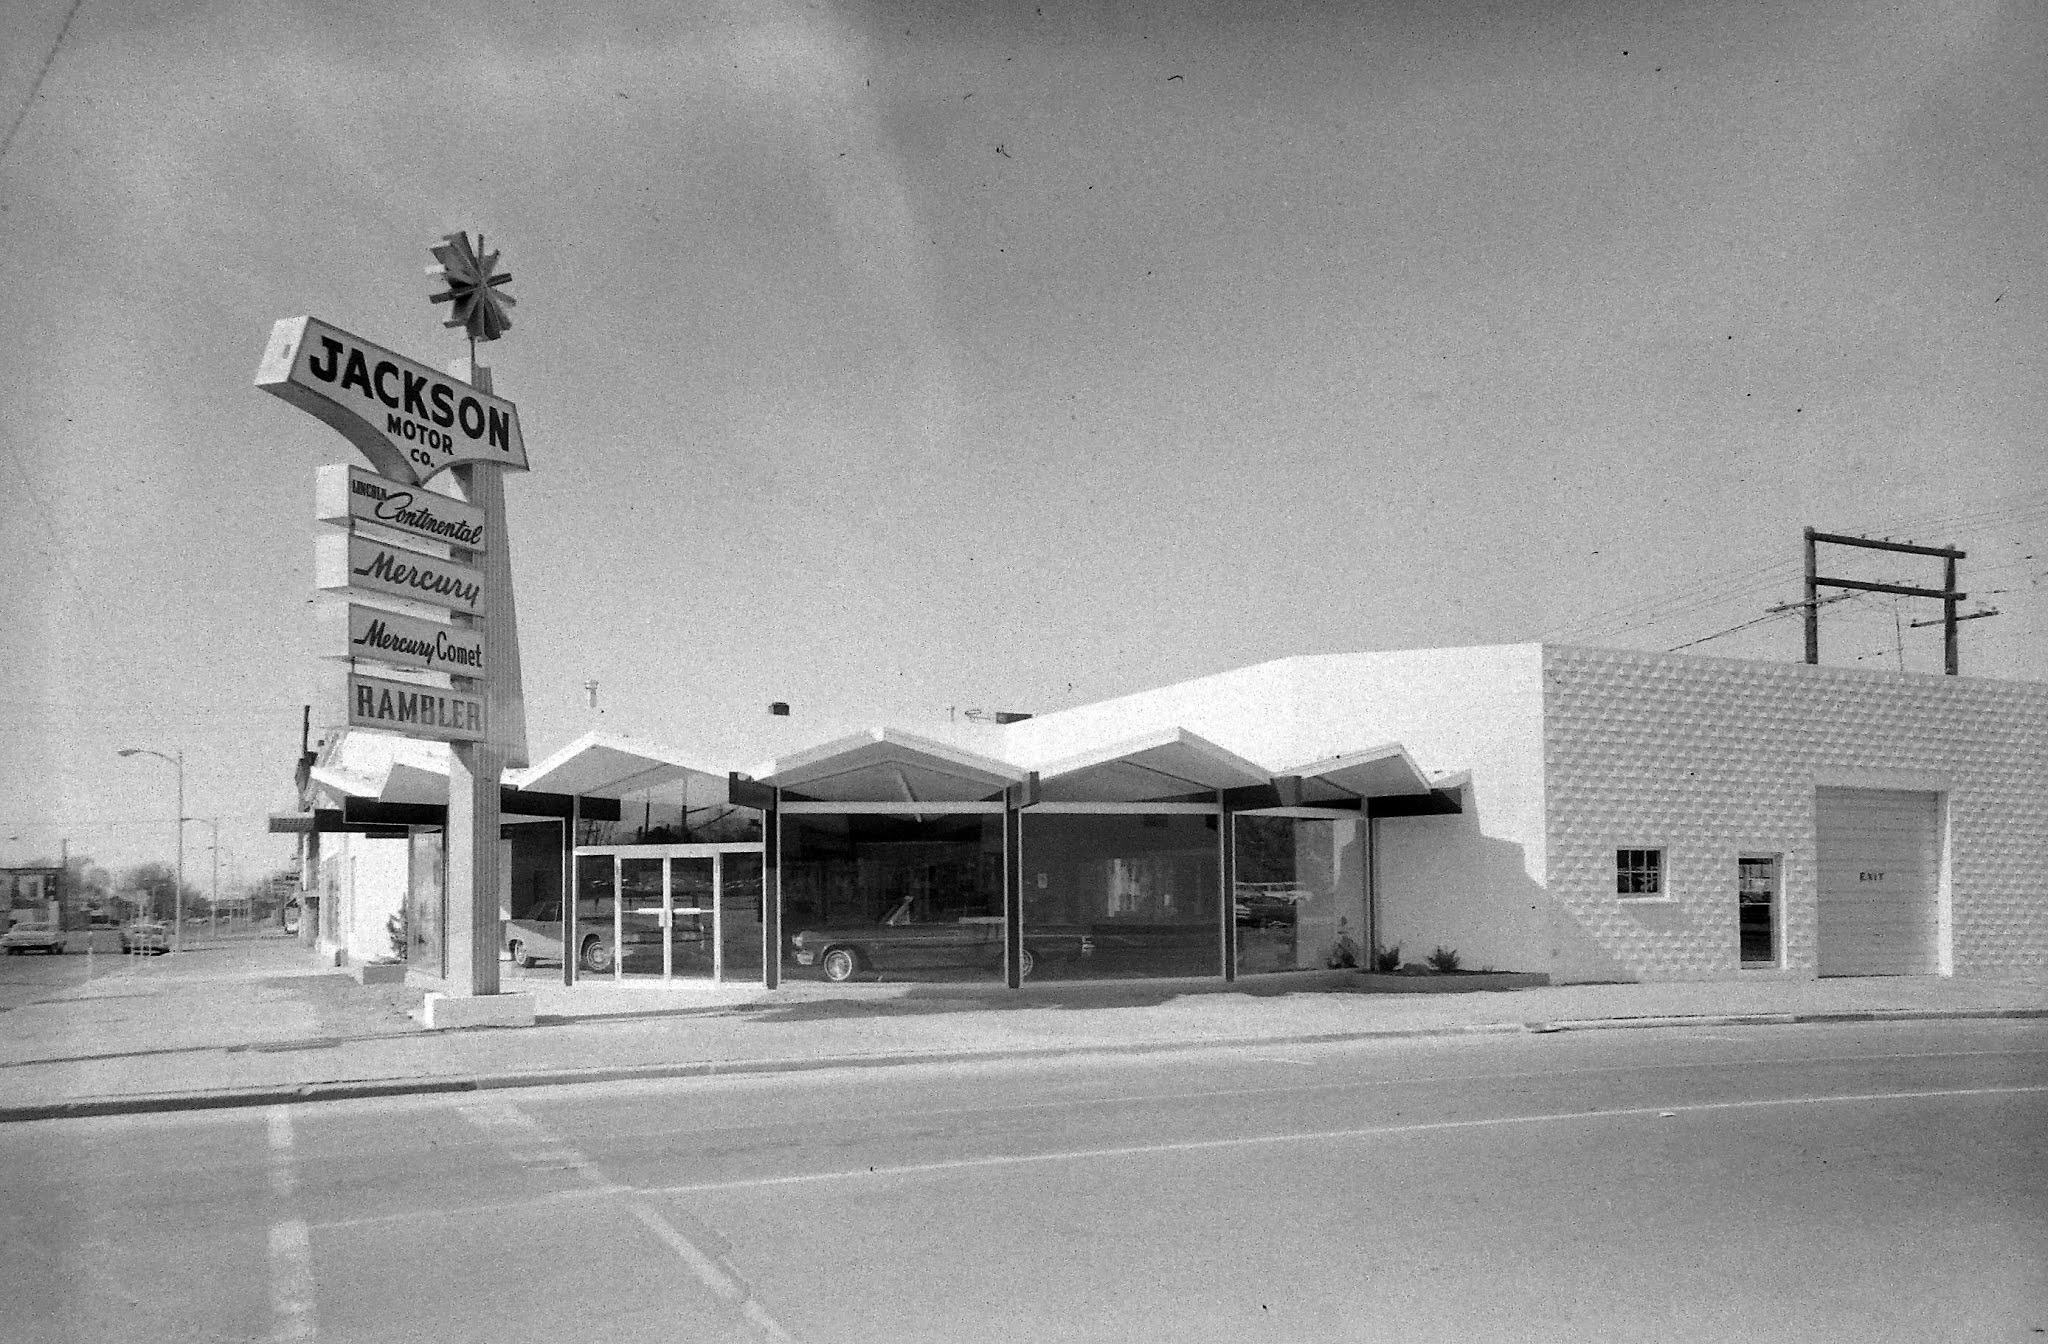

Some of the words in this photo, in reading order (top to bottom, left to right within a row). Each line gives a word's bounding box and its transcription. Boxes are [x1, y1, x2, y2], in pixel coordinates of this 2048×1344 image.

[309, 335, 510, 452] JACKSON
[387, 413, 454, 455] MOTOR
[410, 449, 435, 468] CO.
[374, 491, 483, 545] Continental
[353, 550, 480, 608] Mercury
[353, 618, 435, 664] Mercury
[436, 631, 483, 668] Comet
[357, 684, 481, 732] RAMBLER
[1859, 871, 1885, 882] EXIT
